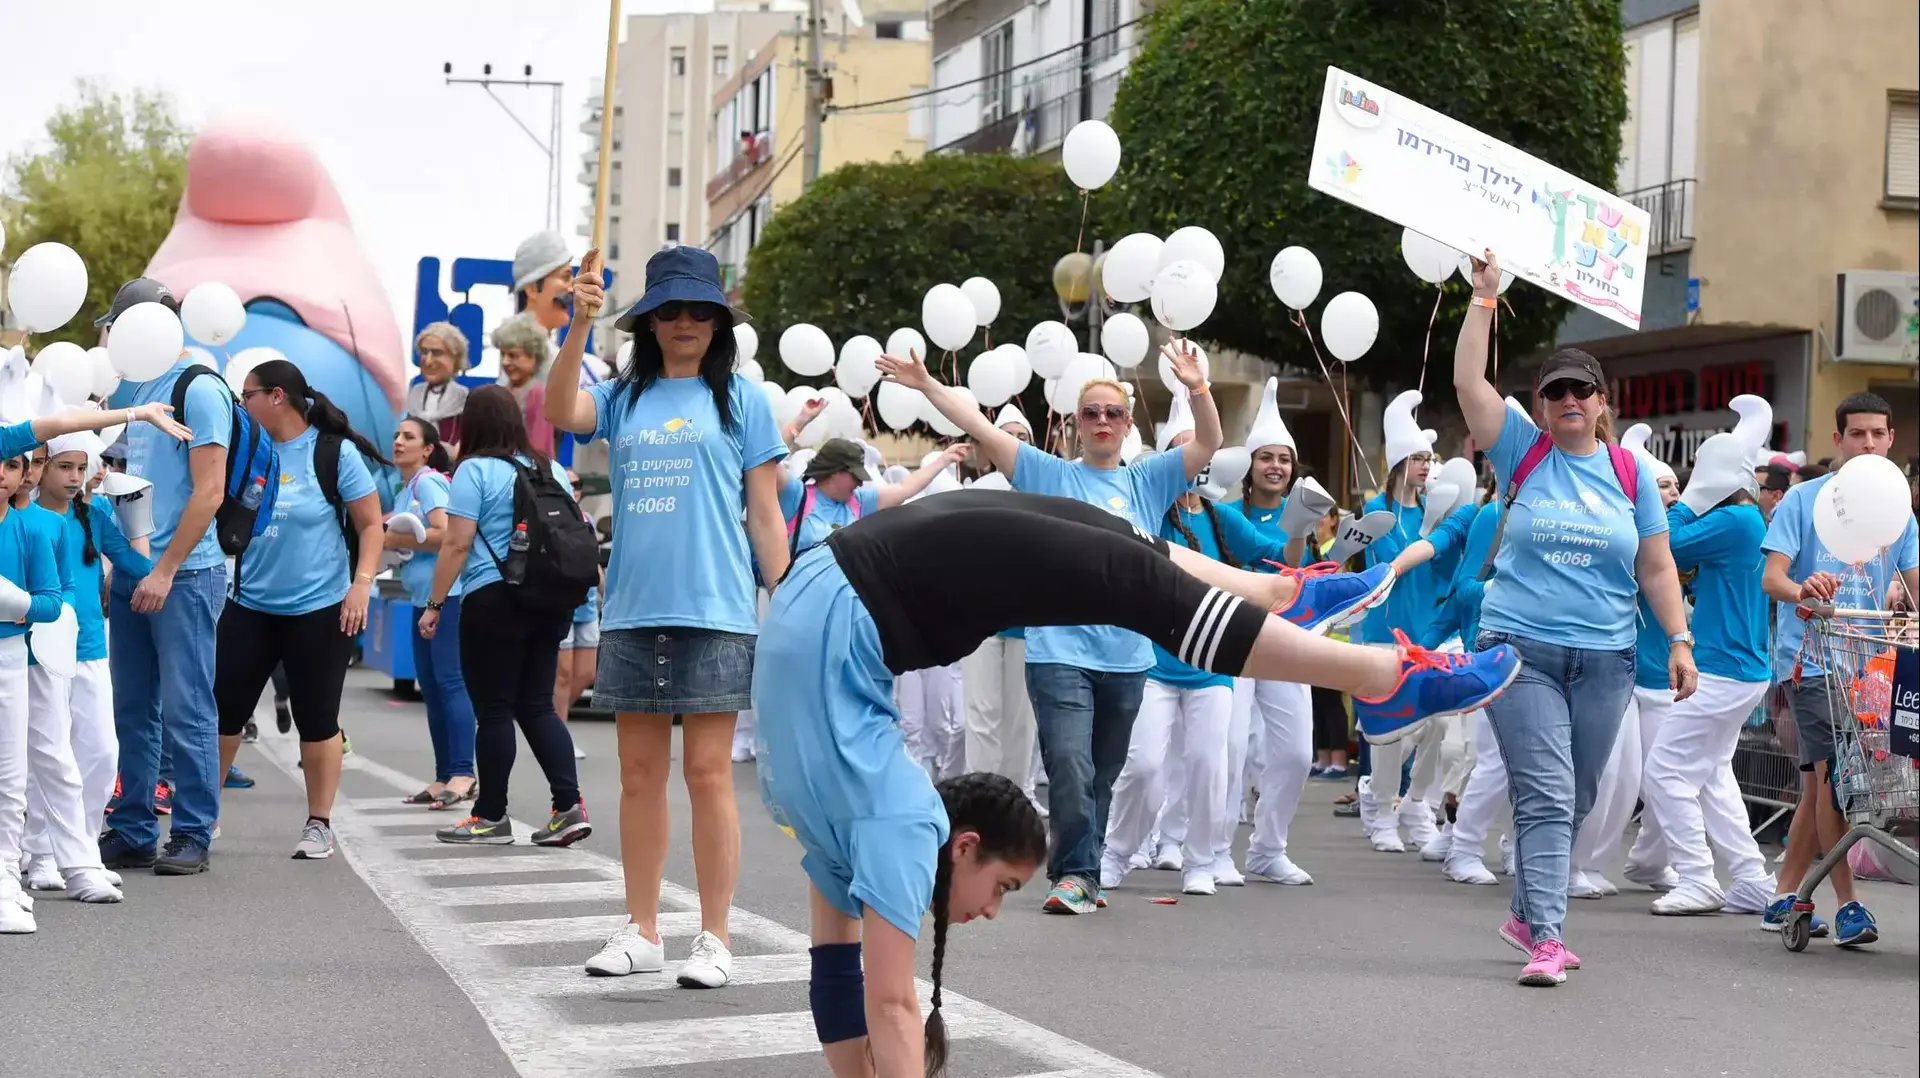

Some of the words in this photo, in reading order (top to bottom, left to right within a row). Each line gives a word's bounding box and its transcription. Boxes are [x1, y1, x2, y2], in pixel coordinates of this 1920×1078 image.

[1397, 128, 1471, 173] פרידמן
[1477, 163, 1523, 195] לילך
[1576, 268, 1620, 297] בחולון
[642, 458, 693, 473] משקיעים
[1531, 495, 1557, 509] Lee
[1531, 518, 1556, 529] ביחד
[1560, 521, 1613, 536] משקיעים
[1531, 531, 1557, 543] ביחד
[1894, 683, 1919, 710] Lee
